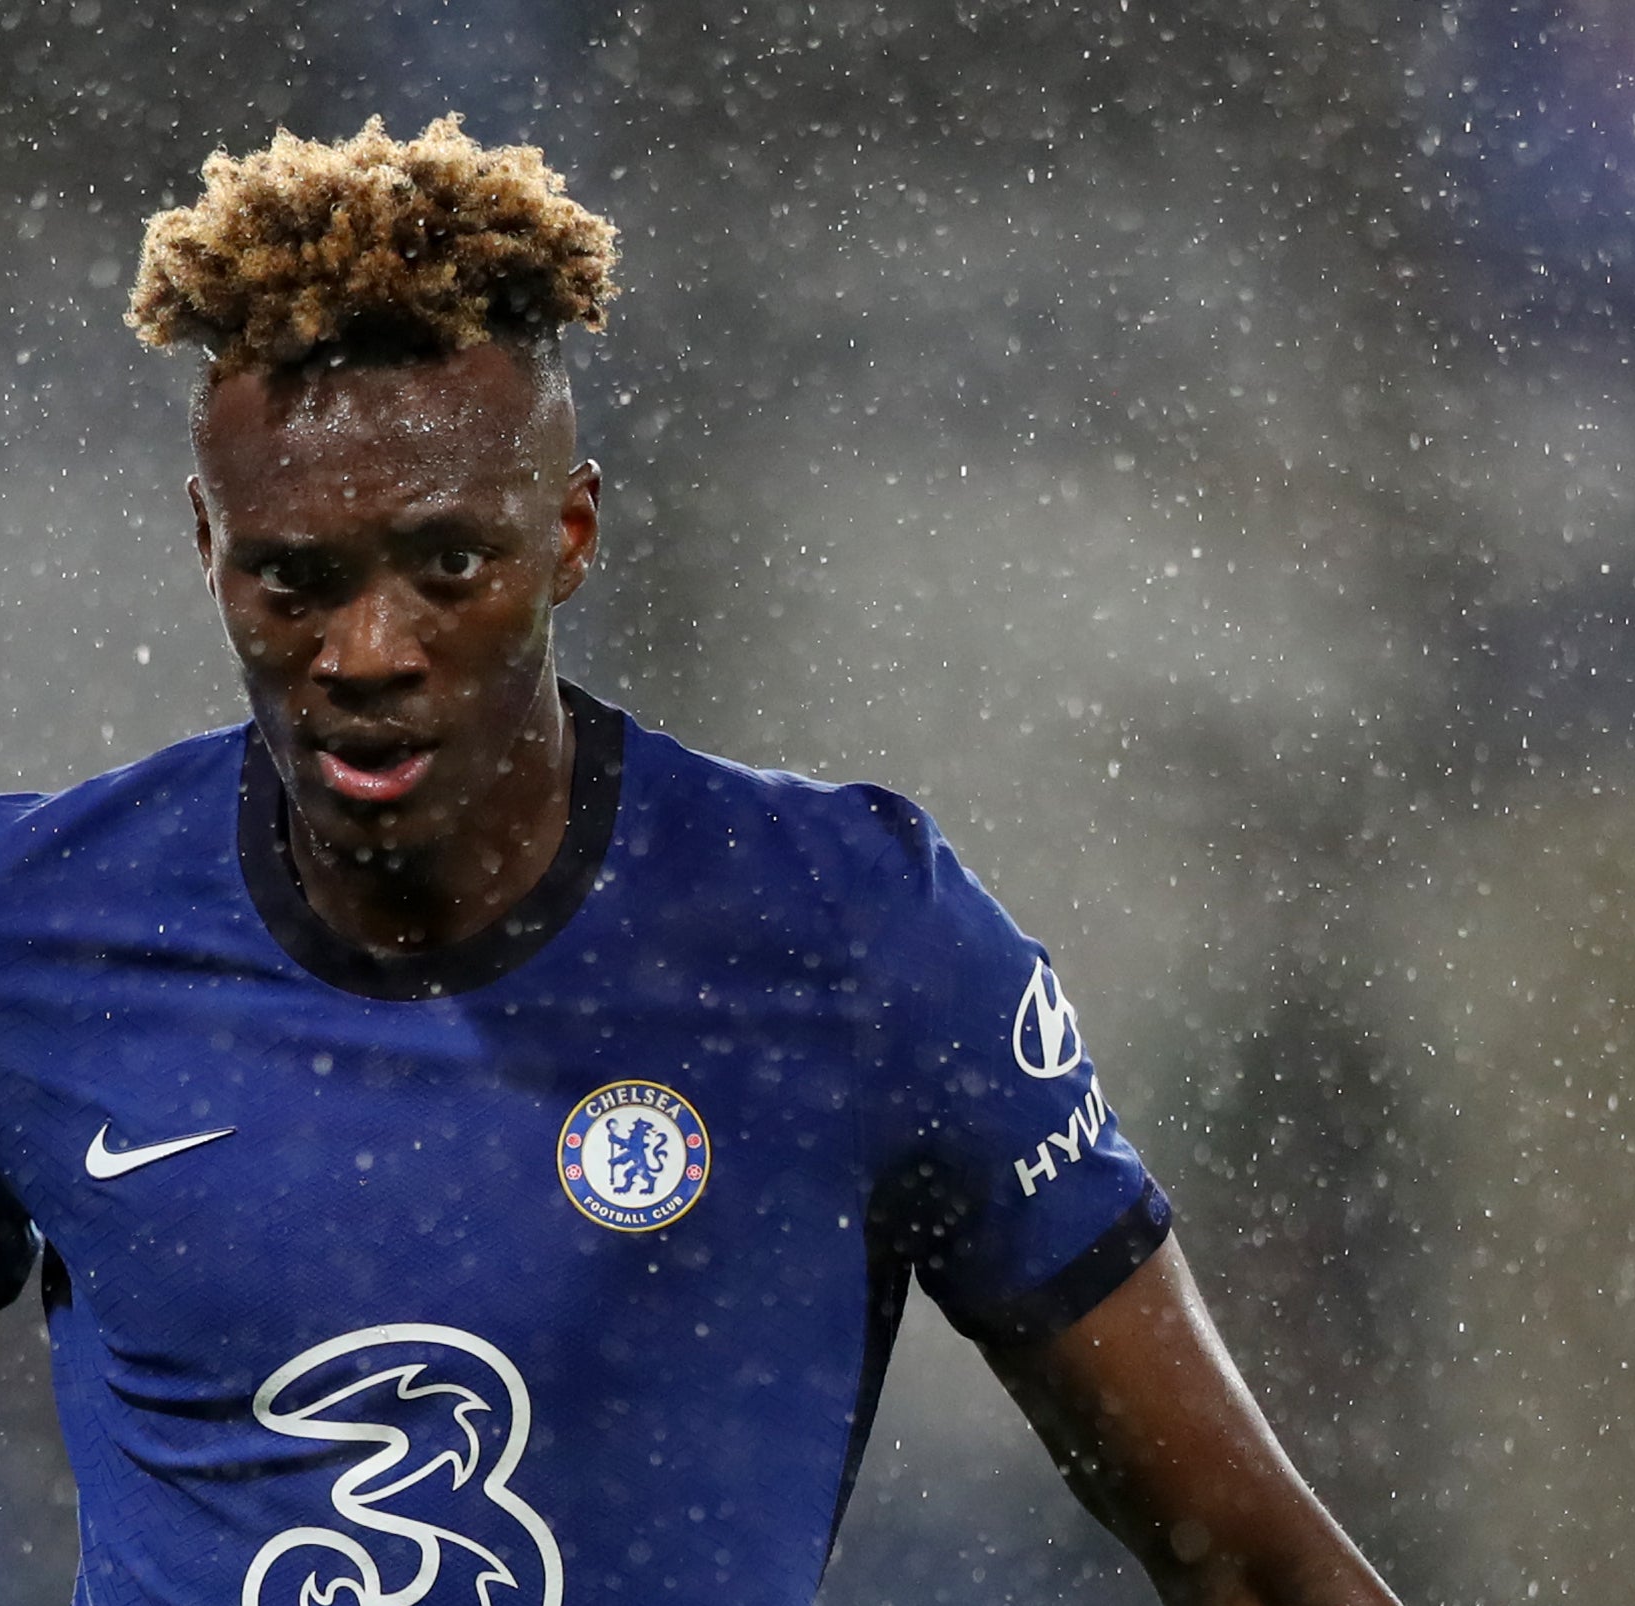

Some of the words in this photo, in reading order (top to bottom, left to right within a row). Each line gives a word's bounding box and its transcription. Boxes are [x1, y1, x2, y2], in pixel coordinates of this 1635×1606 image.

[584, 1086, 684, 1121] CHELSEA
[582, 1195, 648, 1224] FOOTBALL
[652, 1195, 684, 1219] CLUB
